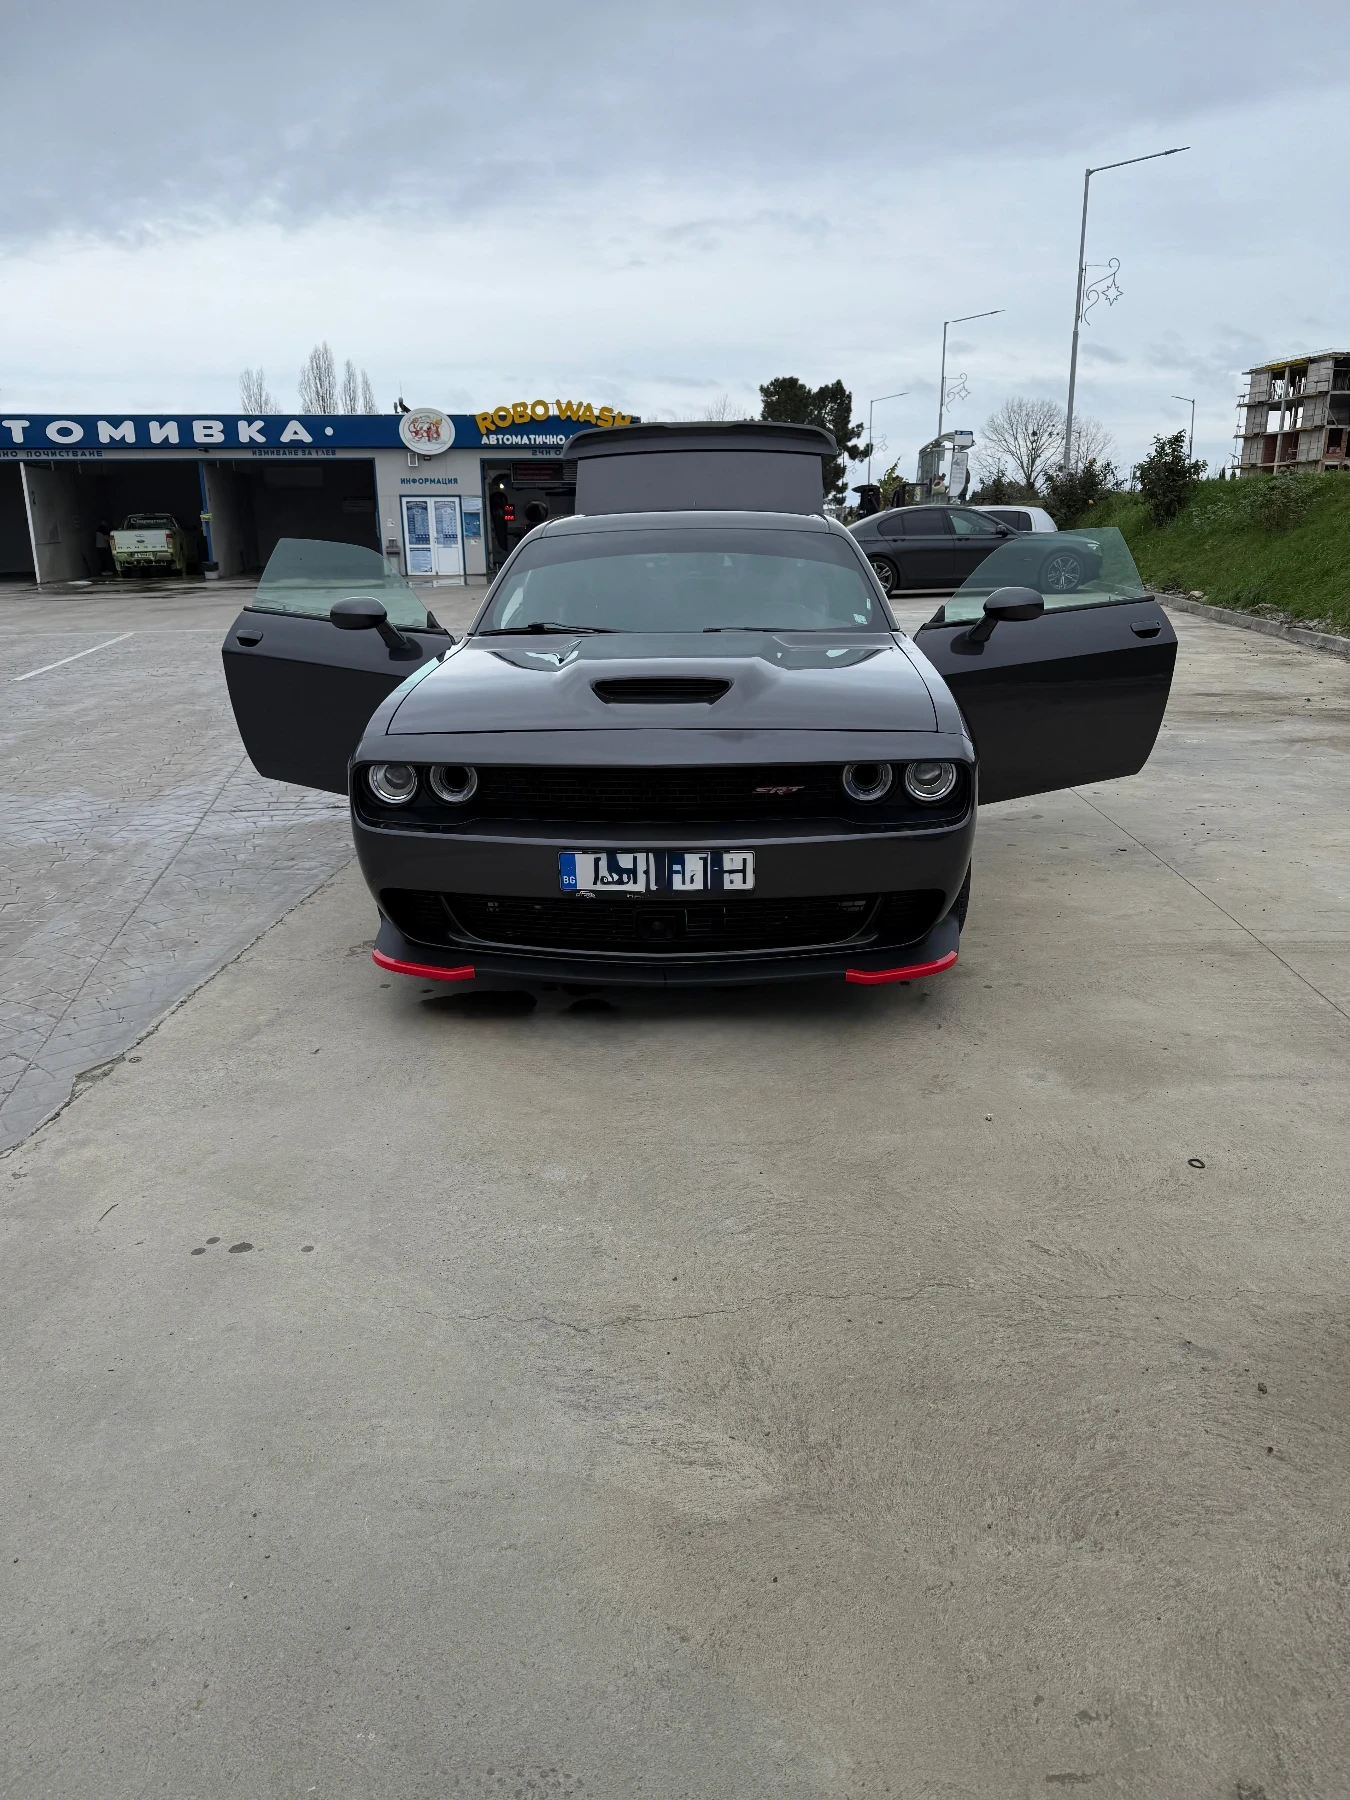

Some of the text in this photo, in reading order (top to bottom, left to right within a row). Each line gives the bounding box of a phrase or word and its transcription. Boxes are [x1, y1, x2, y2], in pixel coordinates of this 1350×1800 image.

[475, 399, 631, 434] ROBO WASH
[1, 420, 313, 444] ТОМИВКА
[481, 434, 566, 445] АВТОМАТИЧНО
[400, 477, 459, 485] ИНФОРМАЦИЯ
[752, 785, 805, 795] SRT
[563, 875, 576, 884] BG
